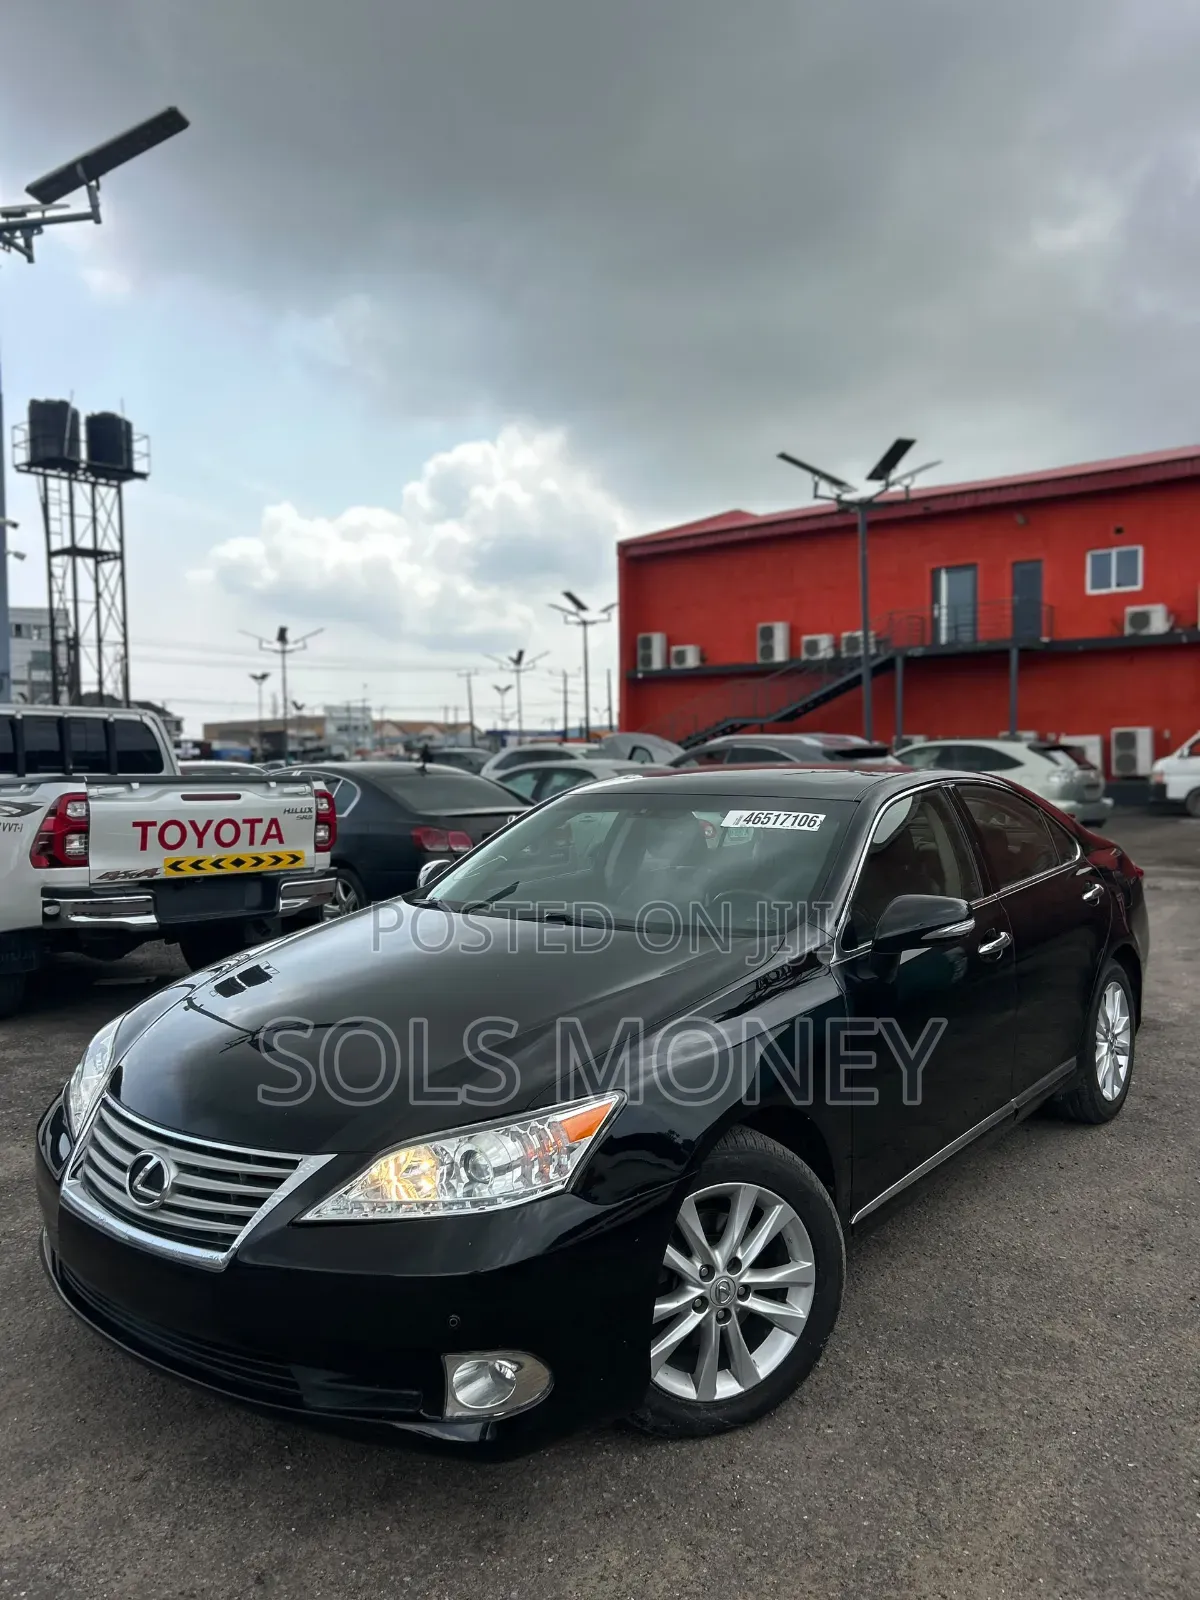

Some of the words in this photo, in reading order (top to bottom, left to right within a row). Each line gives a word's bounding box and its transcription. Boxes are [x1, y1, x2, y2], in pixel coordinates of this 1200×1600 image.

[283, 806, 313, 815] HILUX
[743, 812, 819, 828] 46517106
[132, 817, 285, 852] TOYOTA
